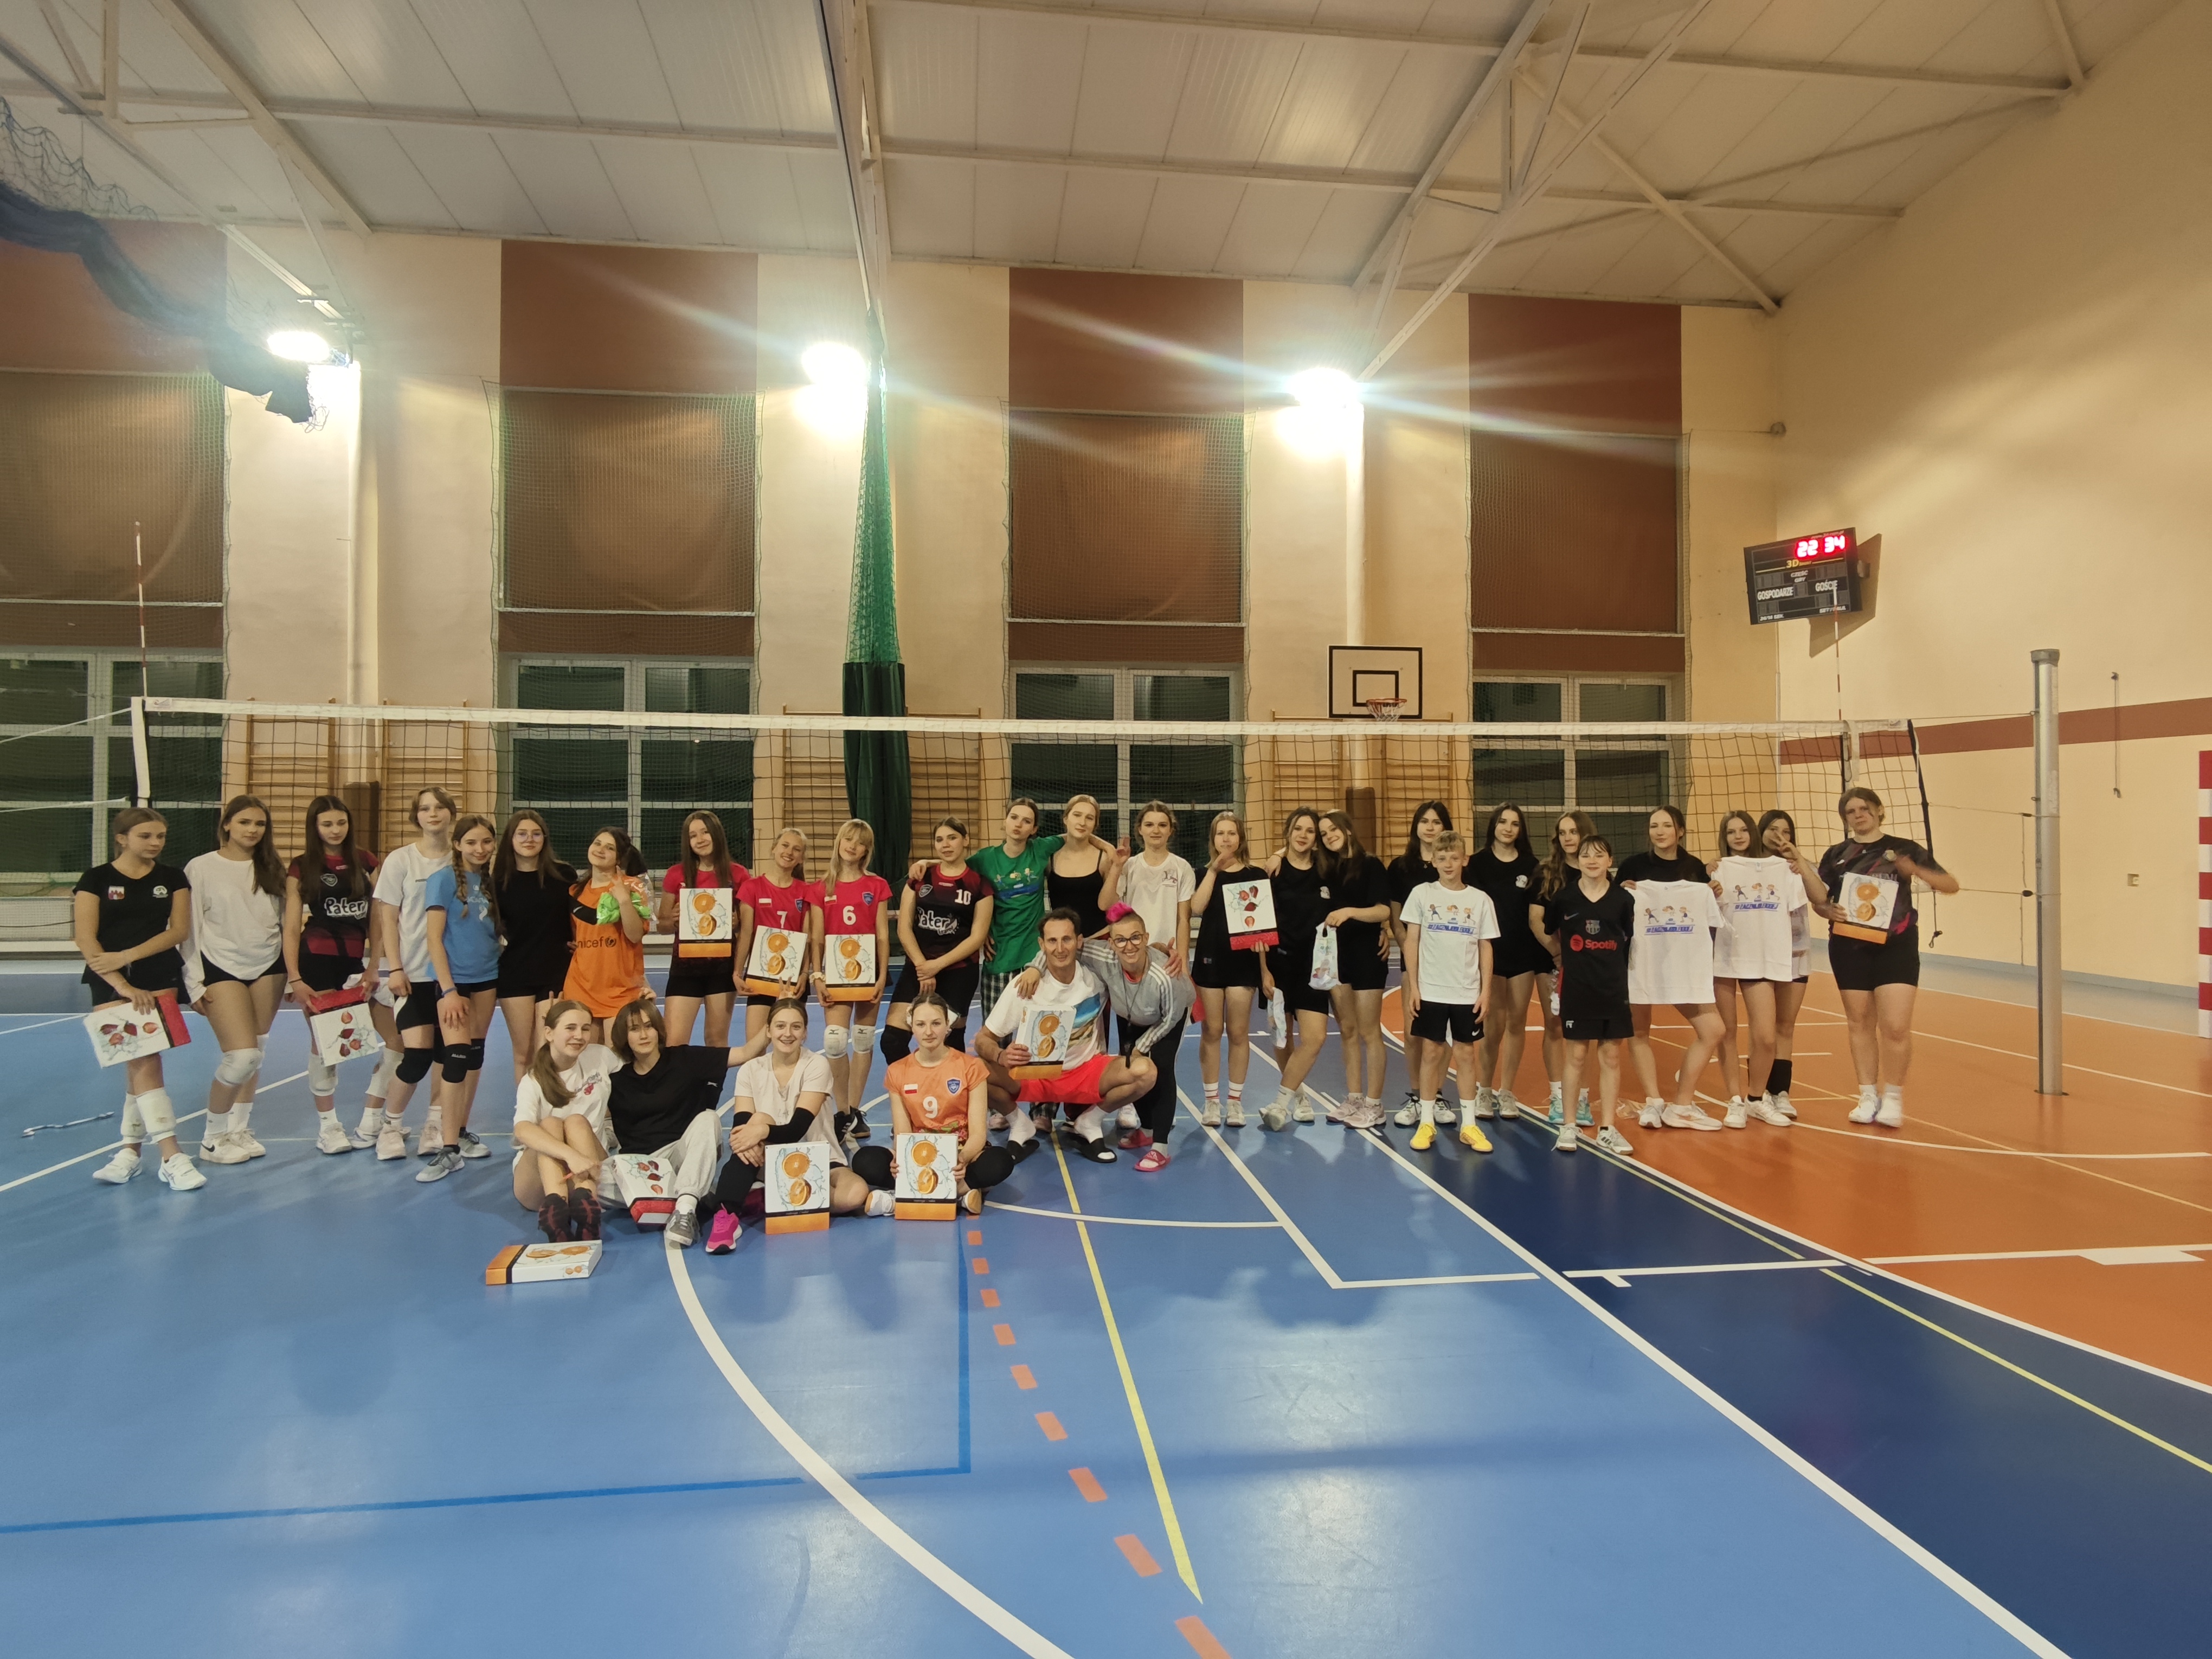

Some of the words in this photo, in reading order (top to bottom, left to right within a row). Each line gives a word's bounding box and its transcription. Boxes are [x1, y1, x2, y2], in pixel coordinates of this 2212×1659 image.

[1797, 539, 1818, 558] 22
[1824, 535, 1846, 553] 34
[1757, 586, 1793, 601] GOSPODARZE
[1815, 579, 1838, 592] GOŚCIE
[954, 889, 972, 905] 10
[325, 897, 364, 915] Pater
[777, 910, 788, 929] 7
[843, 905, 857, 925] 6
[576, 936, 604, 948] nicef
[1585, 938, 1617, 951] Spotify
[923, 1096, 938, 1119] 9
